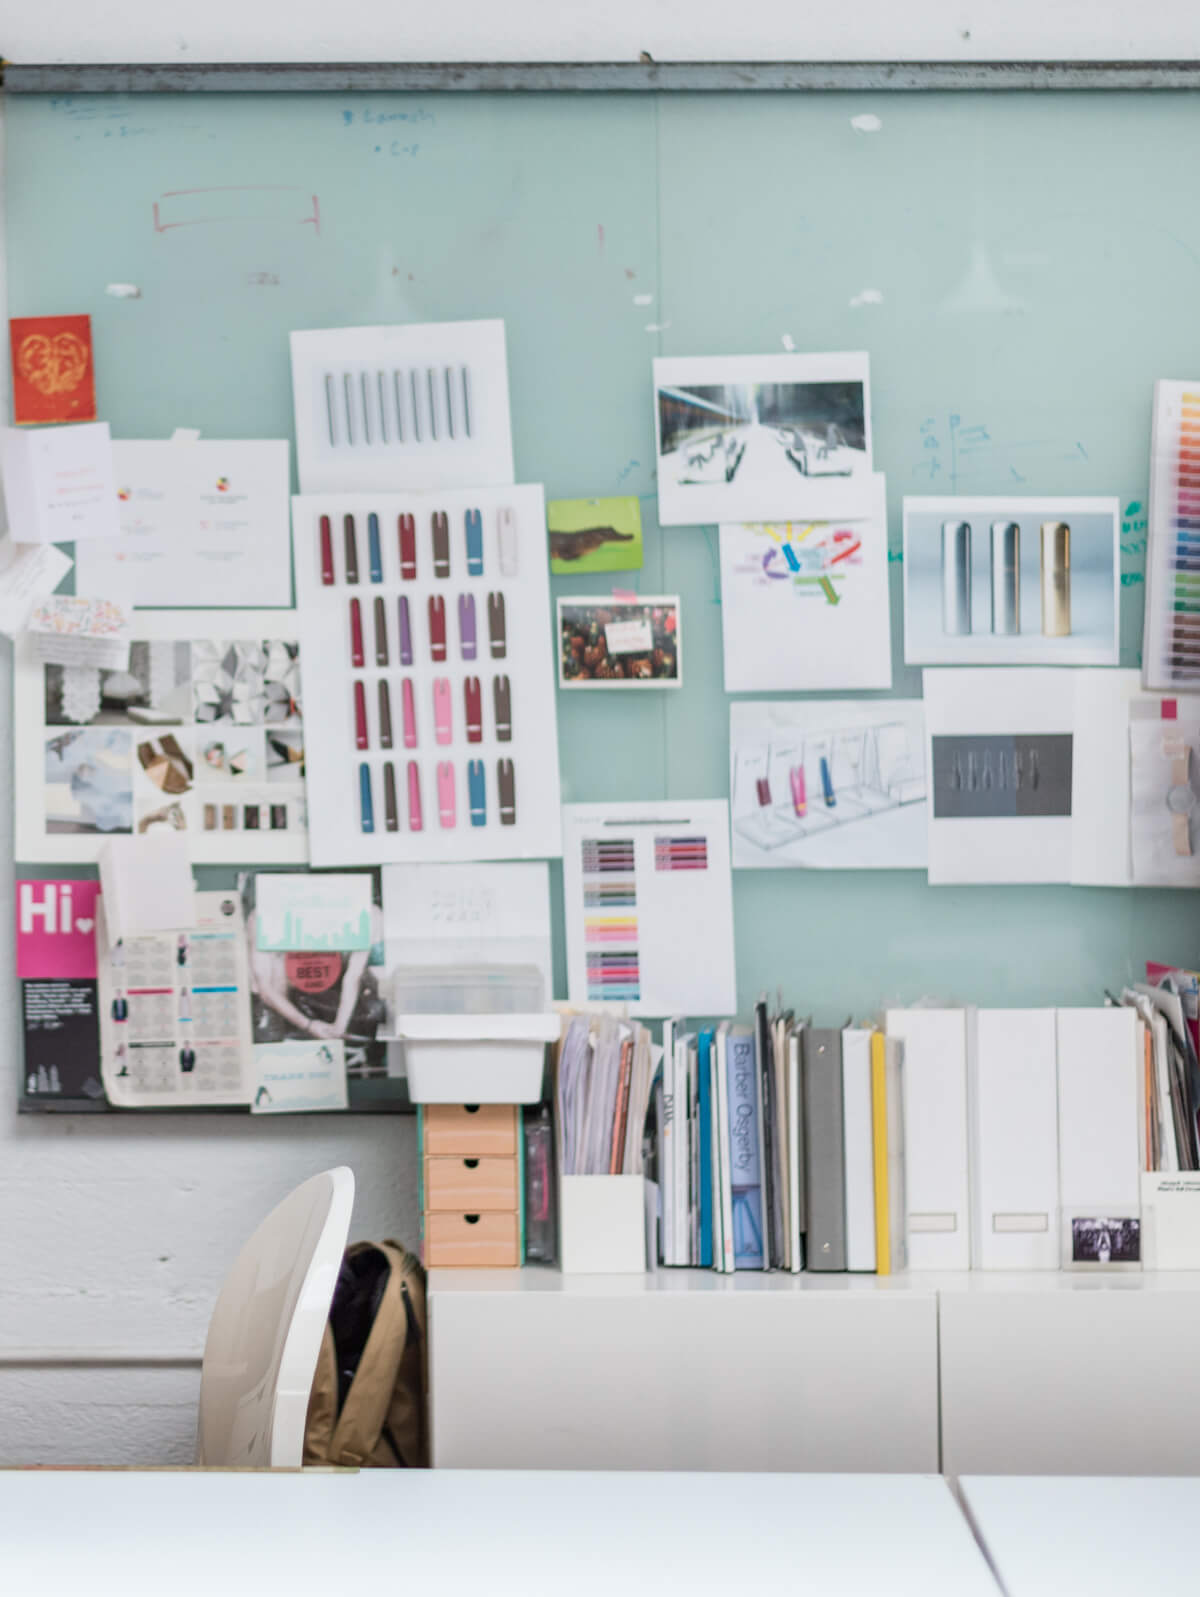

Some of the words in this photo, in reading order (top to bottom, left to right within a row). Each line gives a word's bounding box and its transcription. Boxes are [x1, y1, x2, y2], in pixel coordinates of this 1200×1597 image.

[296, 966, 331, 979] BEST
[734, 1043, 751, 1098] Barber
[733, 1104, 755, 1172] Osgerby
